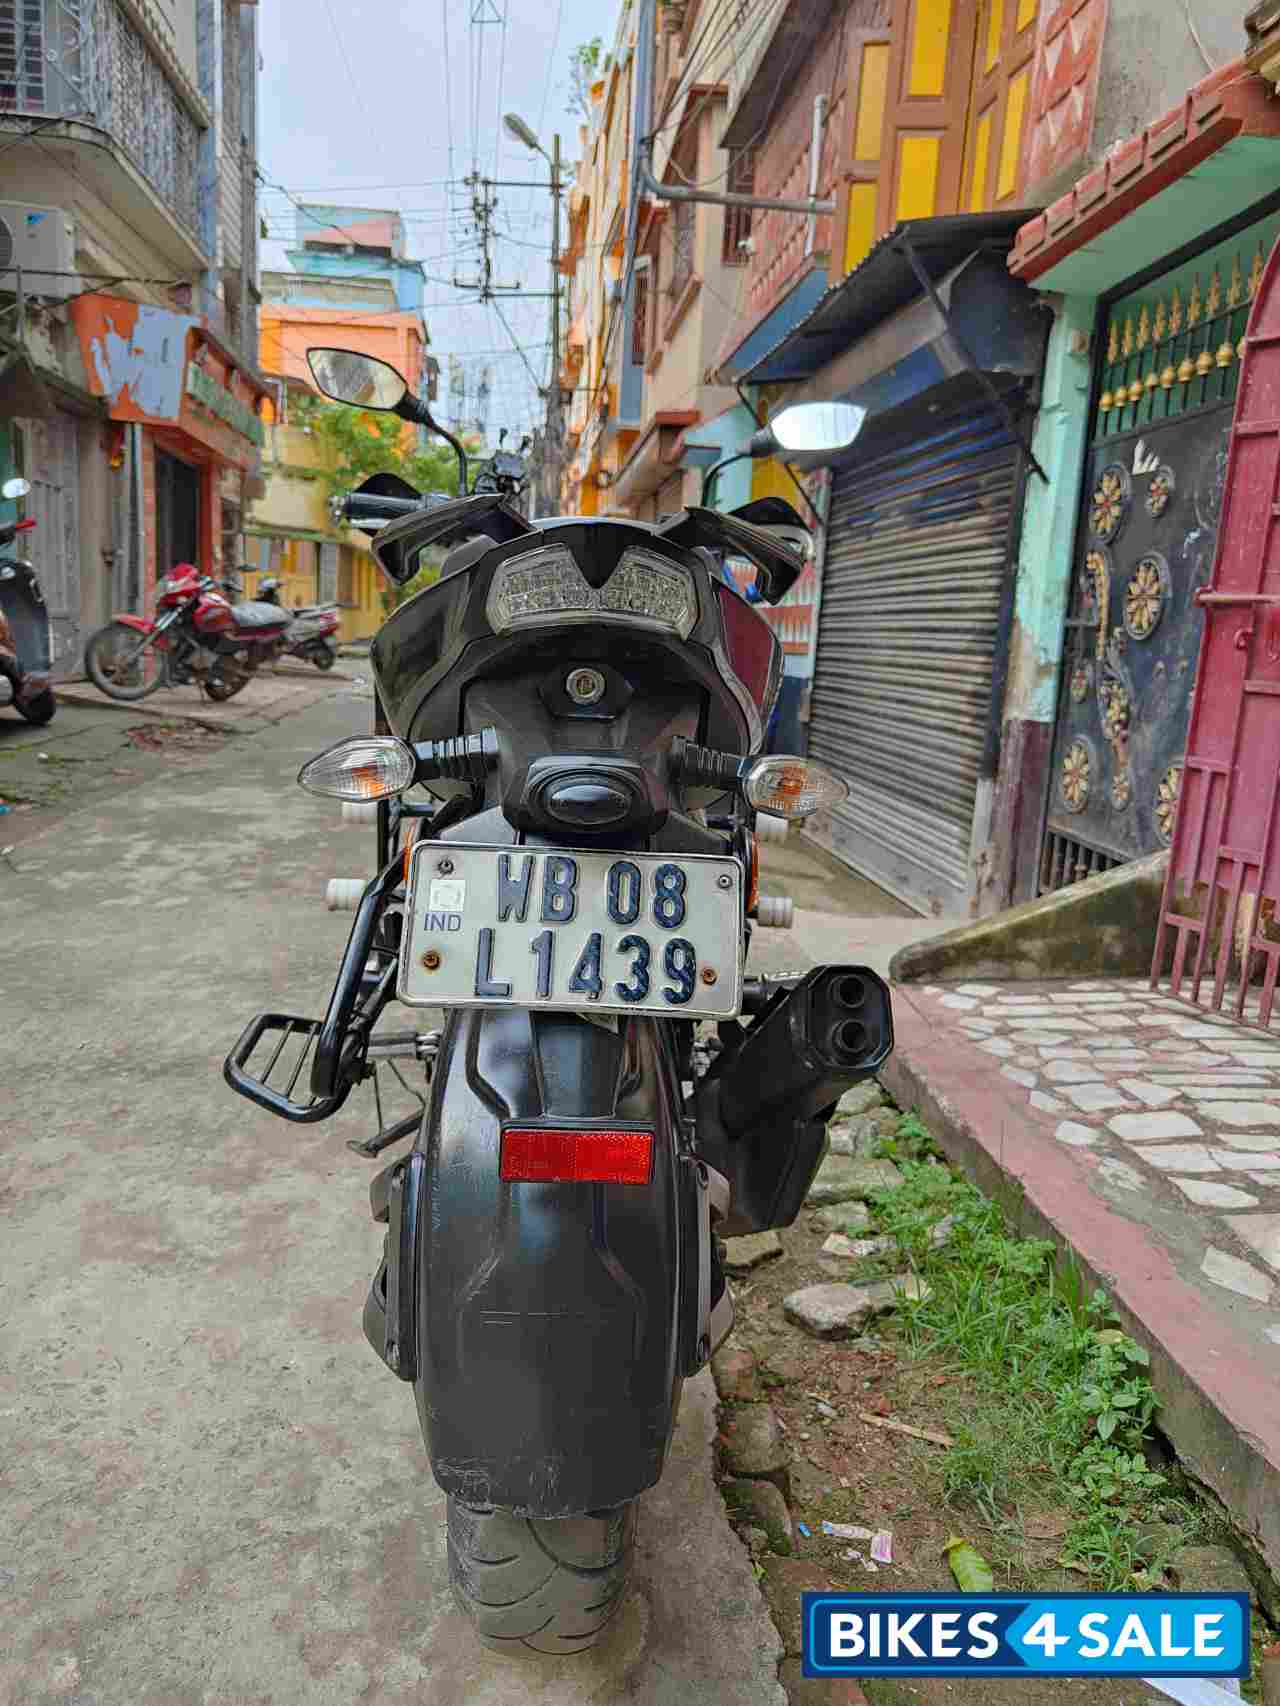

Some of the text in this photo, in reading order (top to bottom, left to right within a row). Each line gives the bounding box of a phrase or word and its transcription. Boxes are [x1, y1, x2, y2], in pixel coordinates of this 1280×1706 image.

[424, 912, 462, 931] IND
[497, 853, 687, 929] WB 08
[474, 927, 697, 1004] L1439
